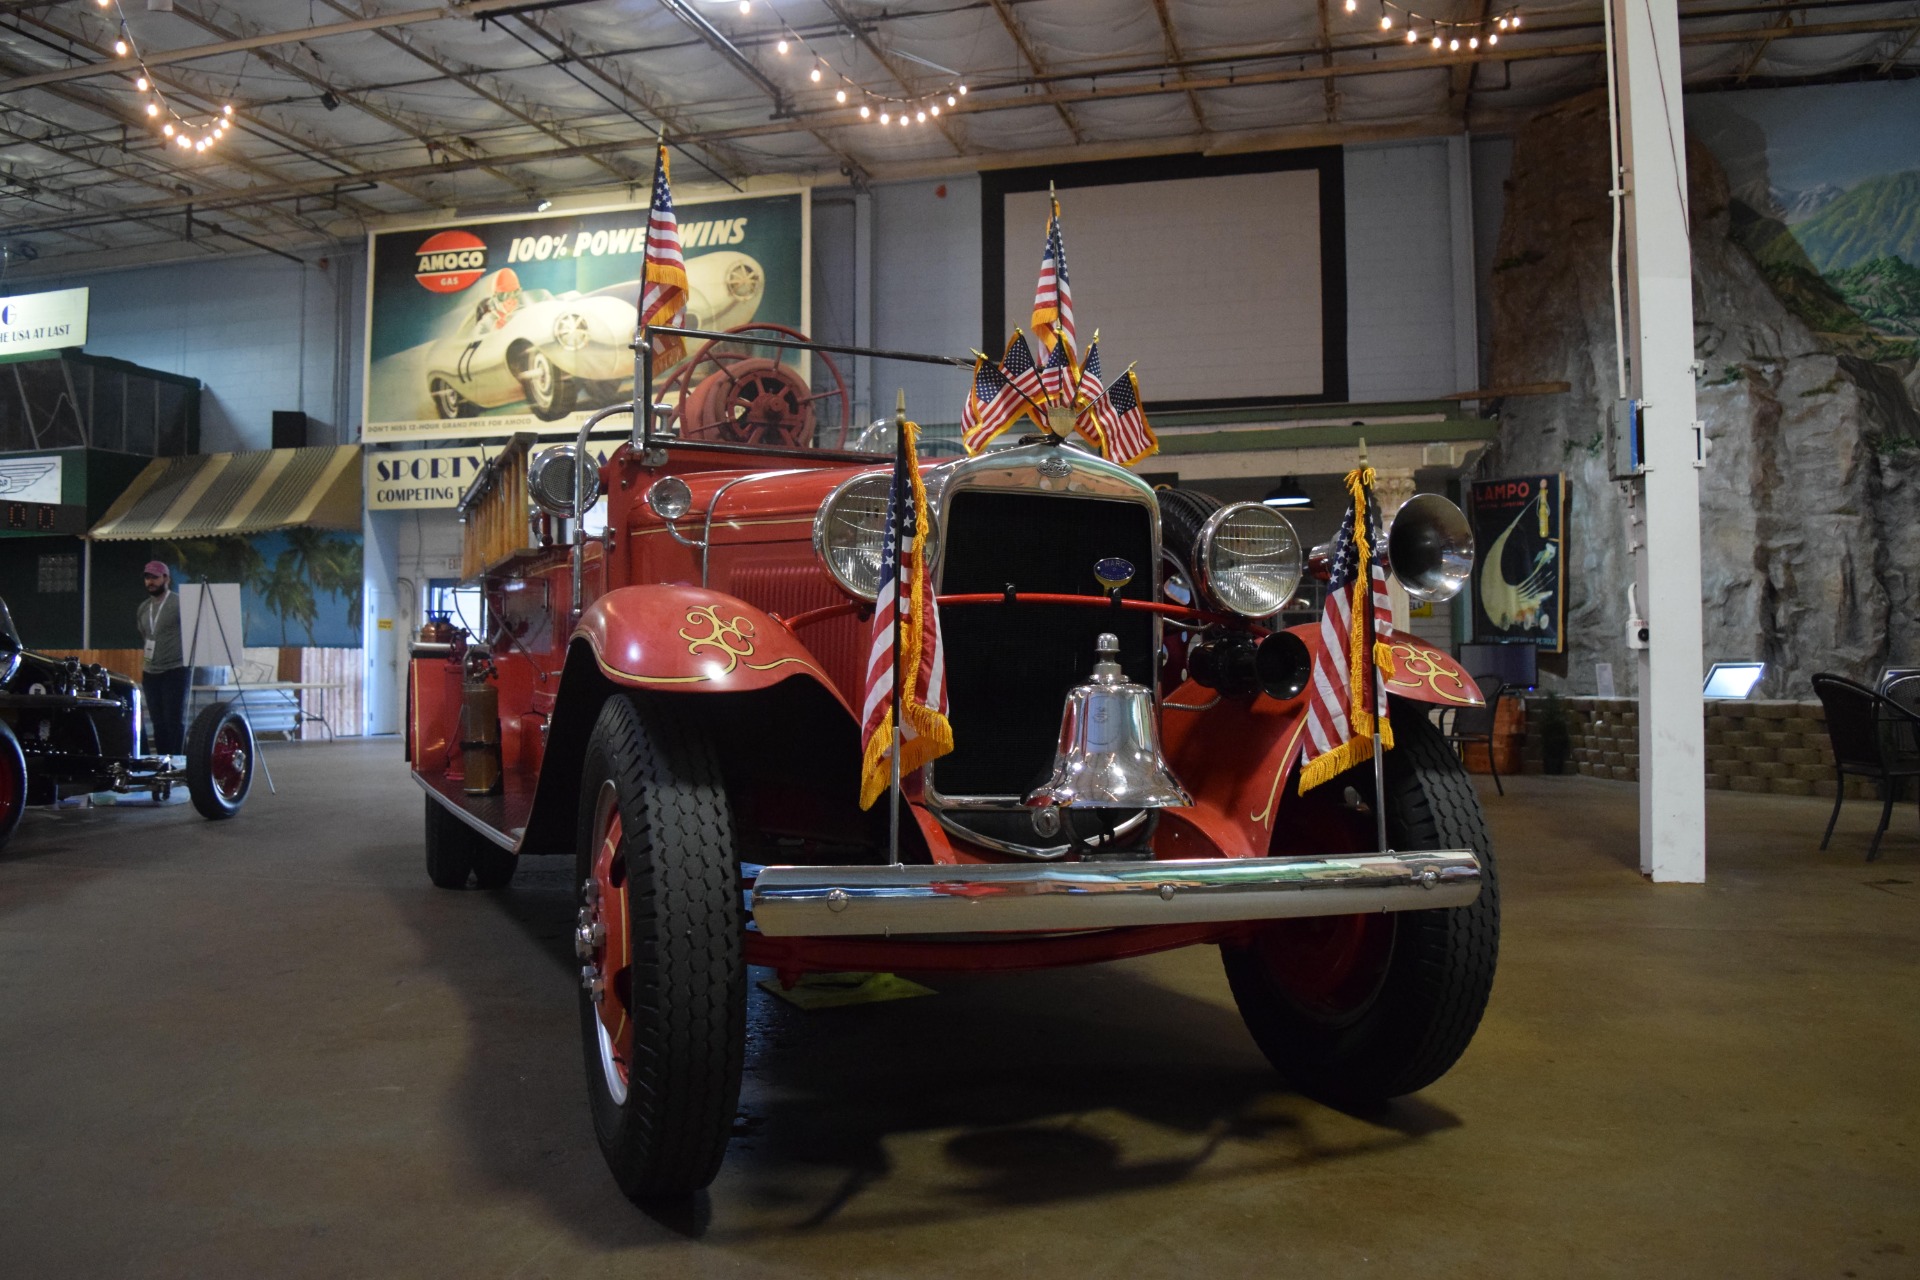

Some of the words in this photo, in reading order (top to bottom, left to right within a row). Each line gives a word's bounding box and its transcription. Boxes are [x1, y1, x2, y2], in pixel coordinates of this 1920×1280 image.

[507, 234, 568, 263] 100%
[573, 227, 646, 257] POWE
[677, 218, 748, 248] WINS
[418, 251, 484, 272] AMOCO
[440, 277, 459, 286] GAS
[12, 329, 30, 341] USA
[33, 327, 45, 339] AT
[47, 324, 71, 338] LAST
[377, 456, 485, 482] SPORTY
[377, 487, 454, 503] COMPETING
[1475, 482, 1530, 500] LAMPO
